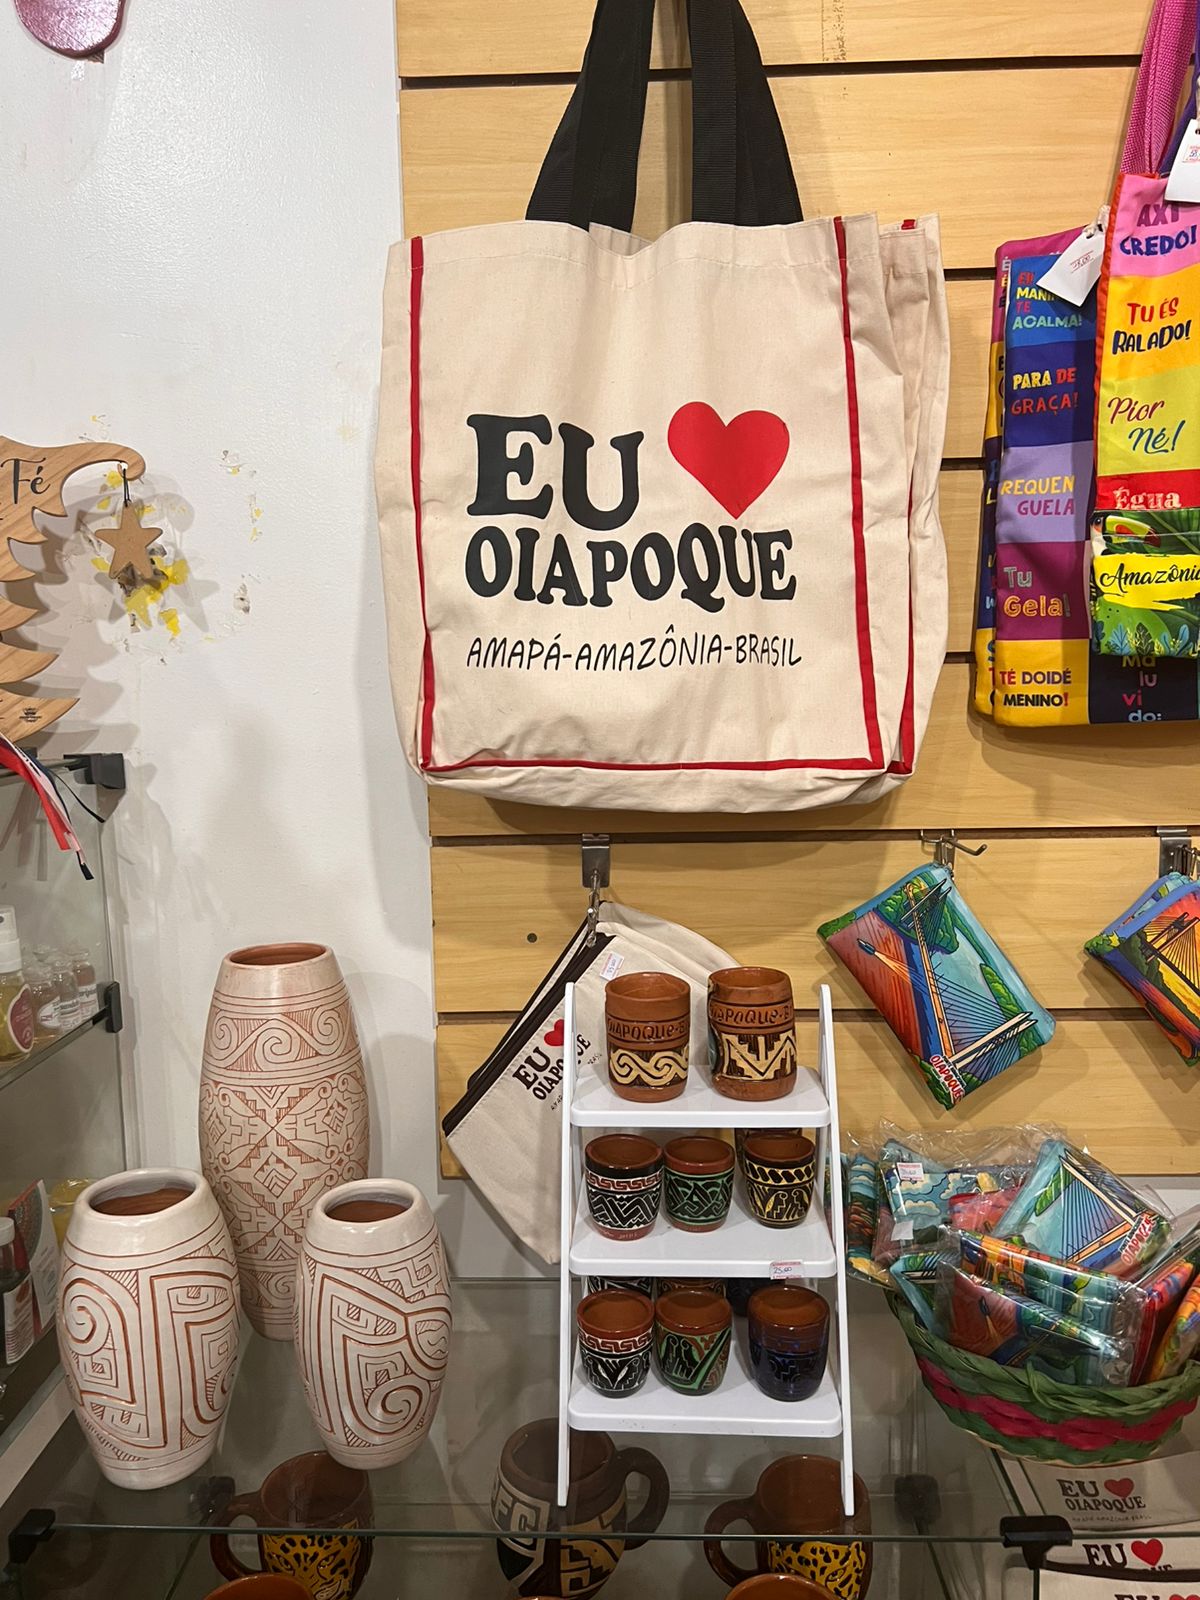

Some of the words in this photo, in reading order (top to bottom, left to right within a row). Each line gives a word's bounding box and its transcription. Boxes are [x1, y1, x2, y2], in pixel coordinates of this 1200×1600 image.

[1015, 300, 1033, 316] TE
[1126, 302, 1155, 326] TU
[1159, 296, 1180, 320] ÉS
[1012, 313, 1083, 331] ACALMA!
[1112, 319, 1192, 355] RALADO!
[1012, 369, 1053, 391] PARA
[1056, 366, 1077, 385] DE
[1010, 391, 1080, 416] GRAÇA!
[1107, 396, 1165, 425] Pior
[1127, 419, 1186, 455] Né!
[0, 457, 51, 505] Fé
[466, 412, 645, 531] EU
[1000, 474, 1075, 496] REQUEN
[1112, 485, 1182, 510] Égua
[1017, 497, 1075, 516] GUELA
[464, 521, 797, 614] OIAPOQUE
[1003, 566, 1033, 588] Tu
[1003, 592, 1071, 619] Gela!
[999, 667, 1017, 686] TÉ
[1021, 667, 1072, 686] DOIDÉ
[1003, 692, 1069, 708] MENINO!
[512, 1046, 551, 1090] EU
[1056, 1478, 1100, 1498] EU
[1064, 1496, 1147, 1514] OIAPOQUE
[1082, 1542, 1128, 1569] EU
